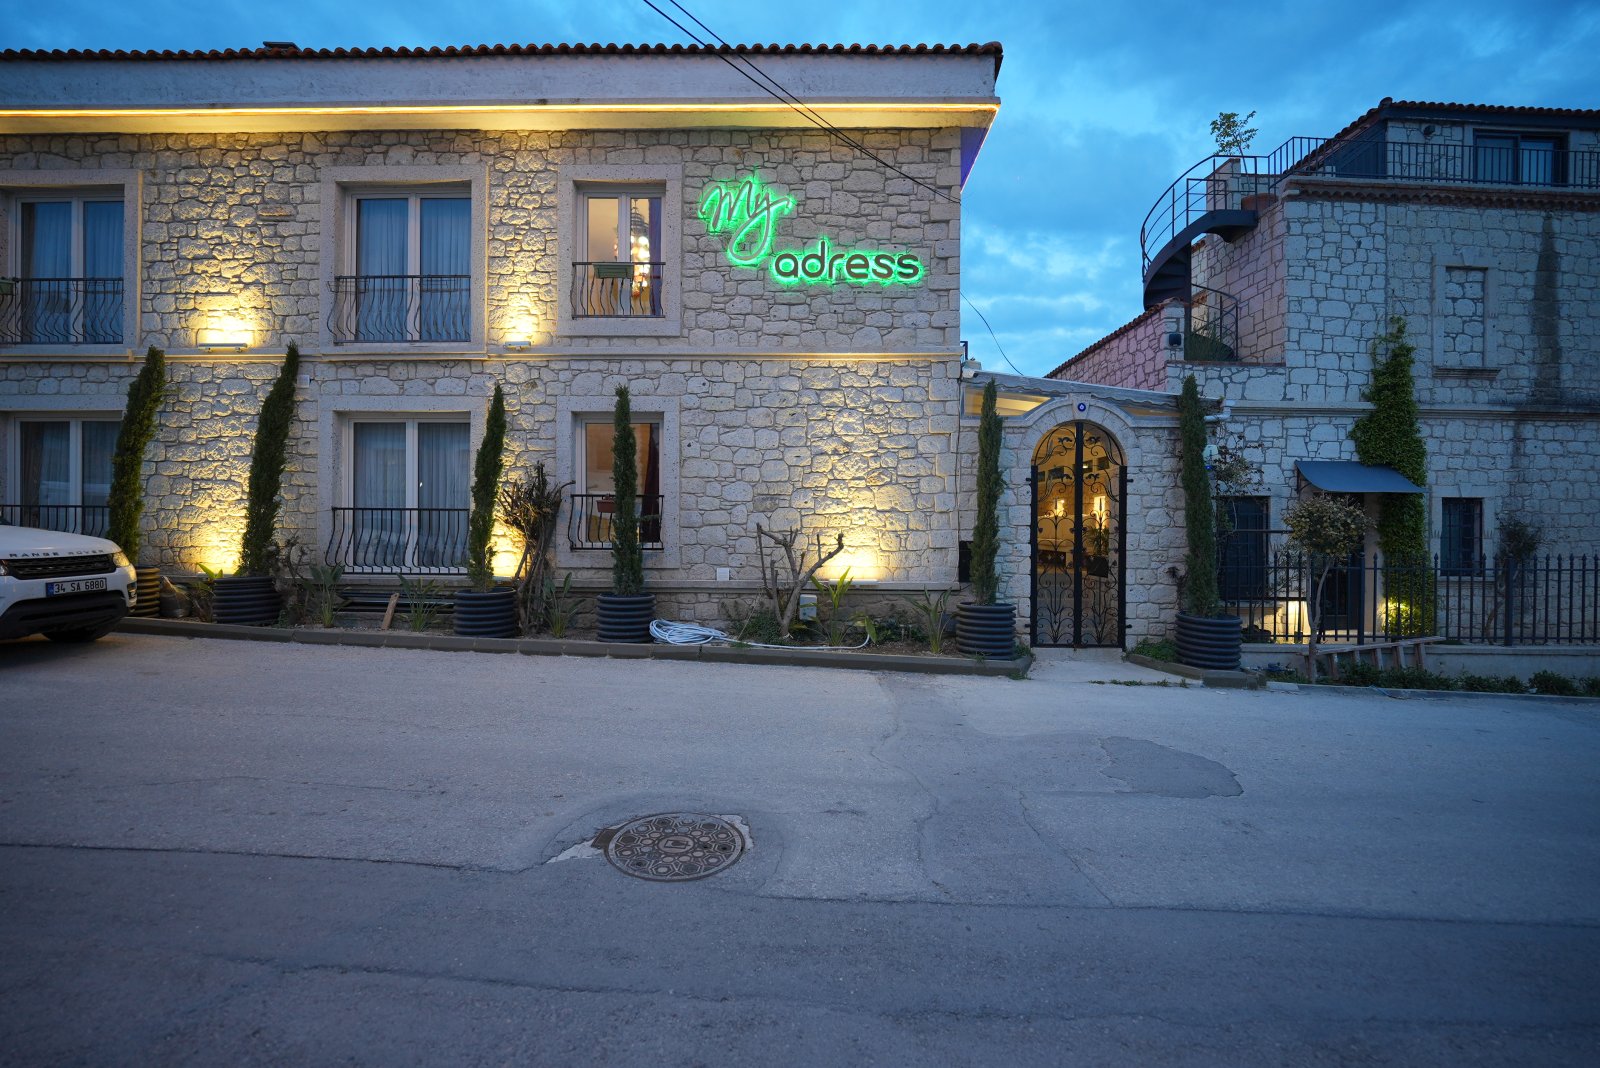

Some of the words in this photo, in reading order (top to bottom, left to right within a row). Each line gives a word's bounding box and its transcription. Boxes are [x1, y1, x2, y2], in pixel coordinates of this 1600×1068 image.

[699, 180, 791, 261] My
[774, 240, 920, 279] adress
[54, 583, 66, 593] 34
[70, 581, 81, 592] SA
